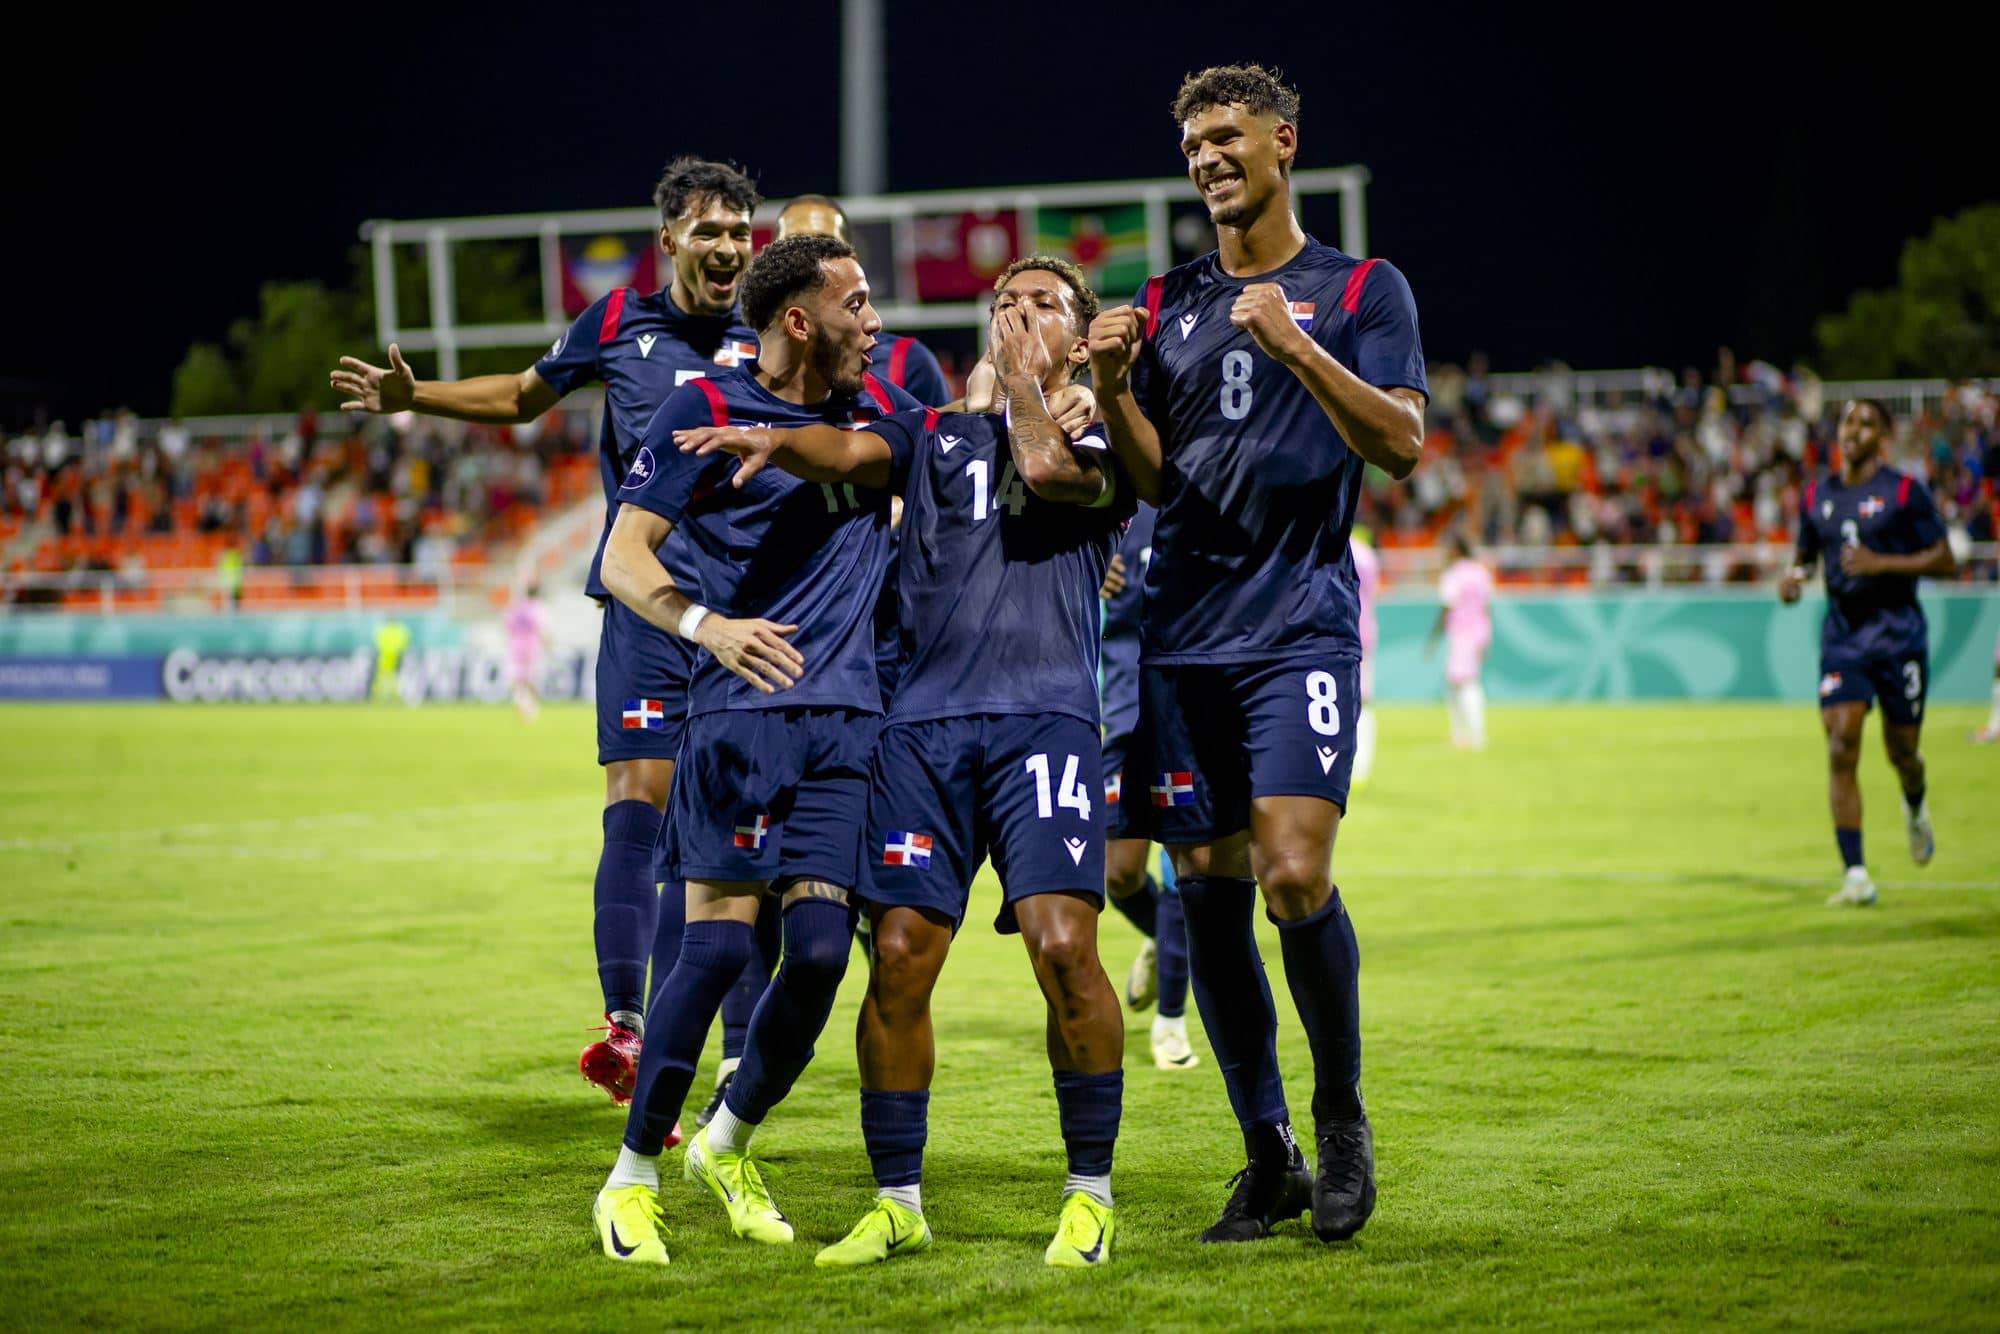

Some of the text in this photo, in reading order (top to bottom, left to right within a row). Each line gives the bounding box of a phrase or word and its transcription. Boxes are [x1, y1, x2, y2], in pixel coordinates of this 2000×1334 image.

[1220, 350, 1253, 420] 8
[966, 459, 1027, 520] 14
[164, 648, 374, 702] Concacaf
[1306, 671, 1340, 736] 8
[1903, 661, 1922, 700] 3
[1025, 753, 1091, 821] 14
